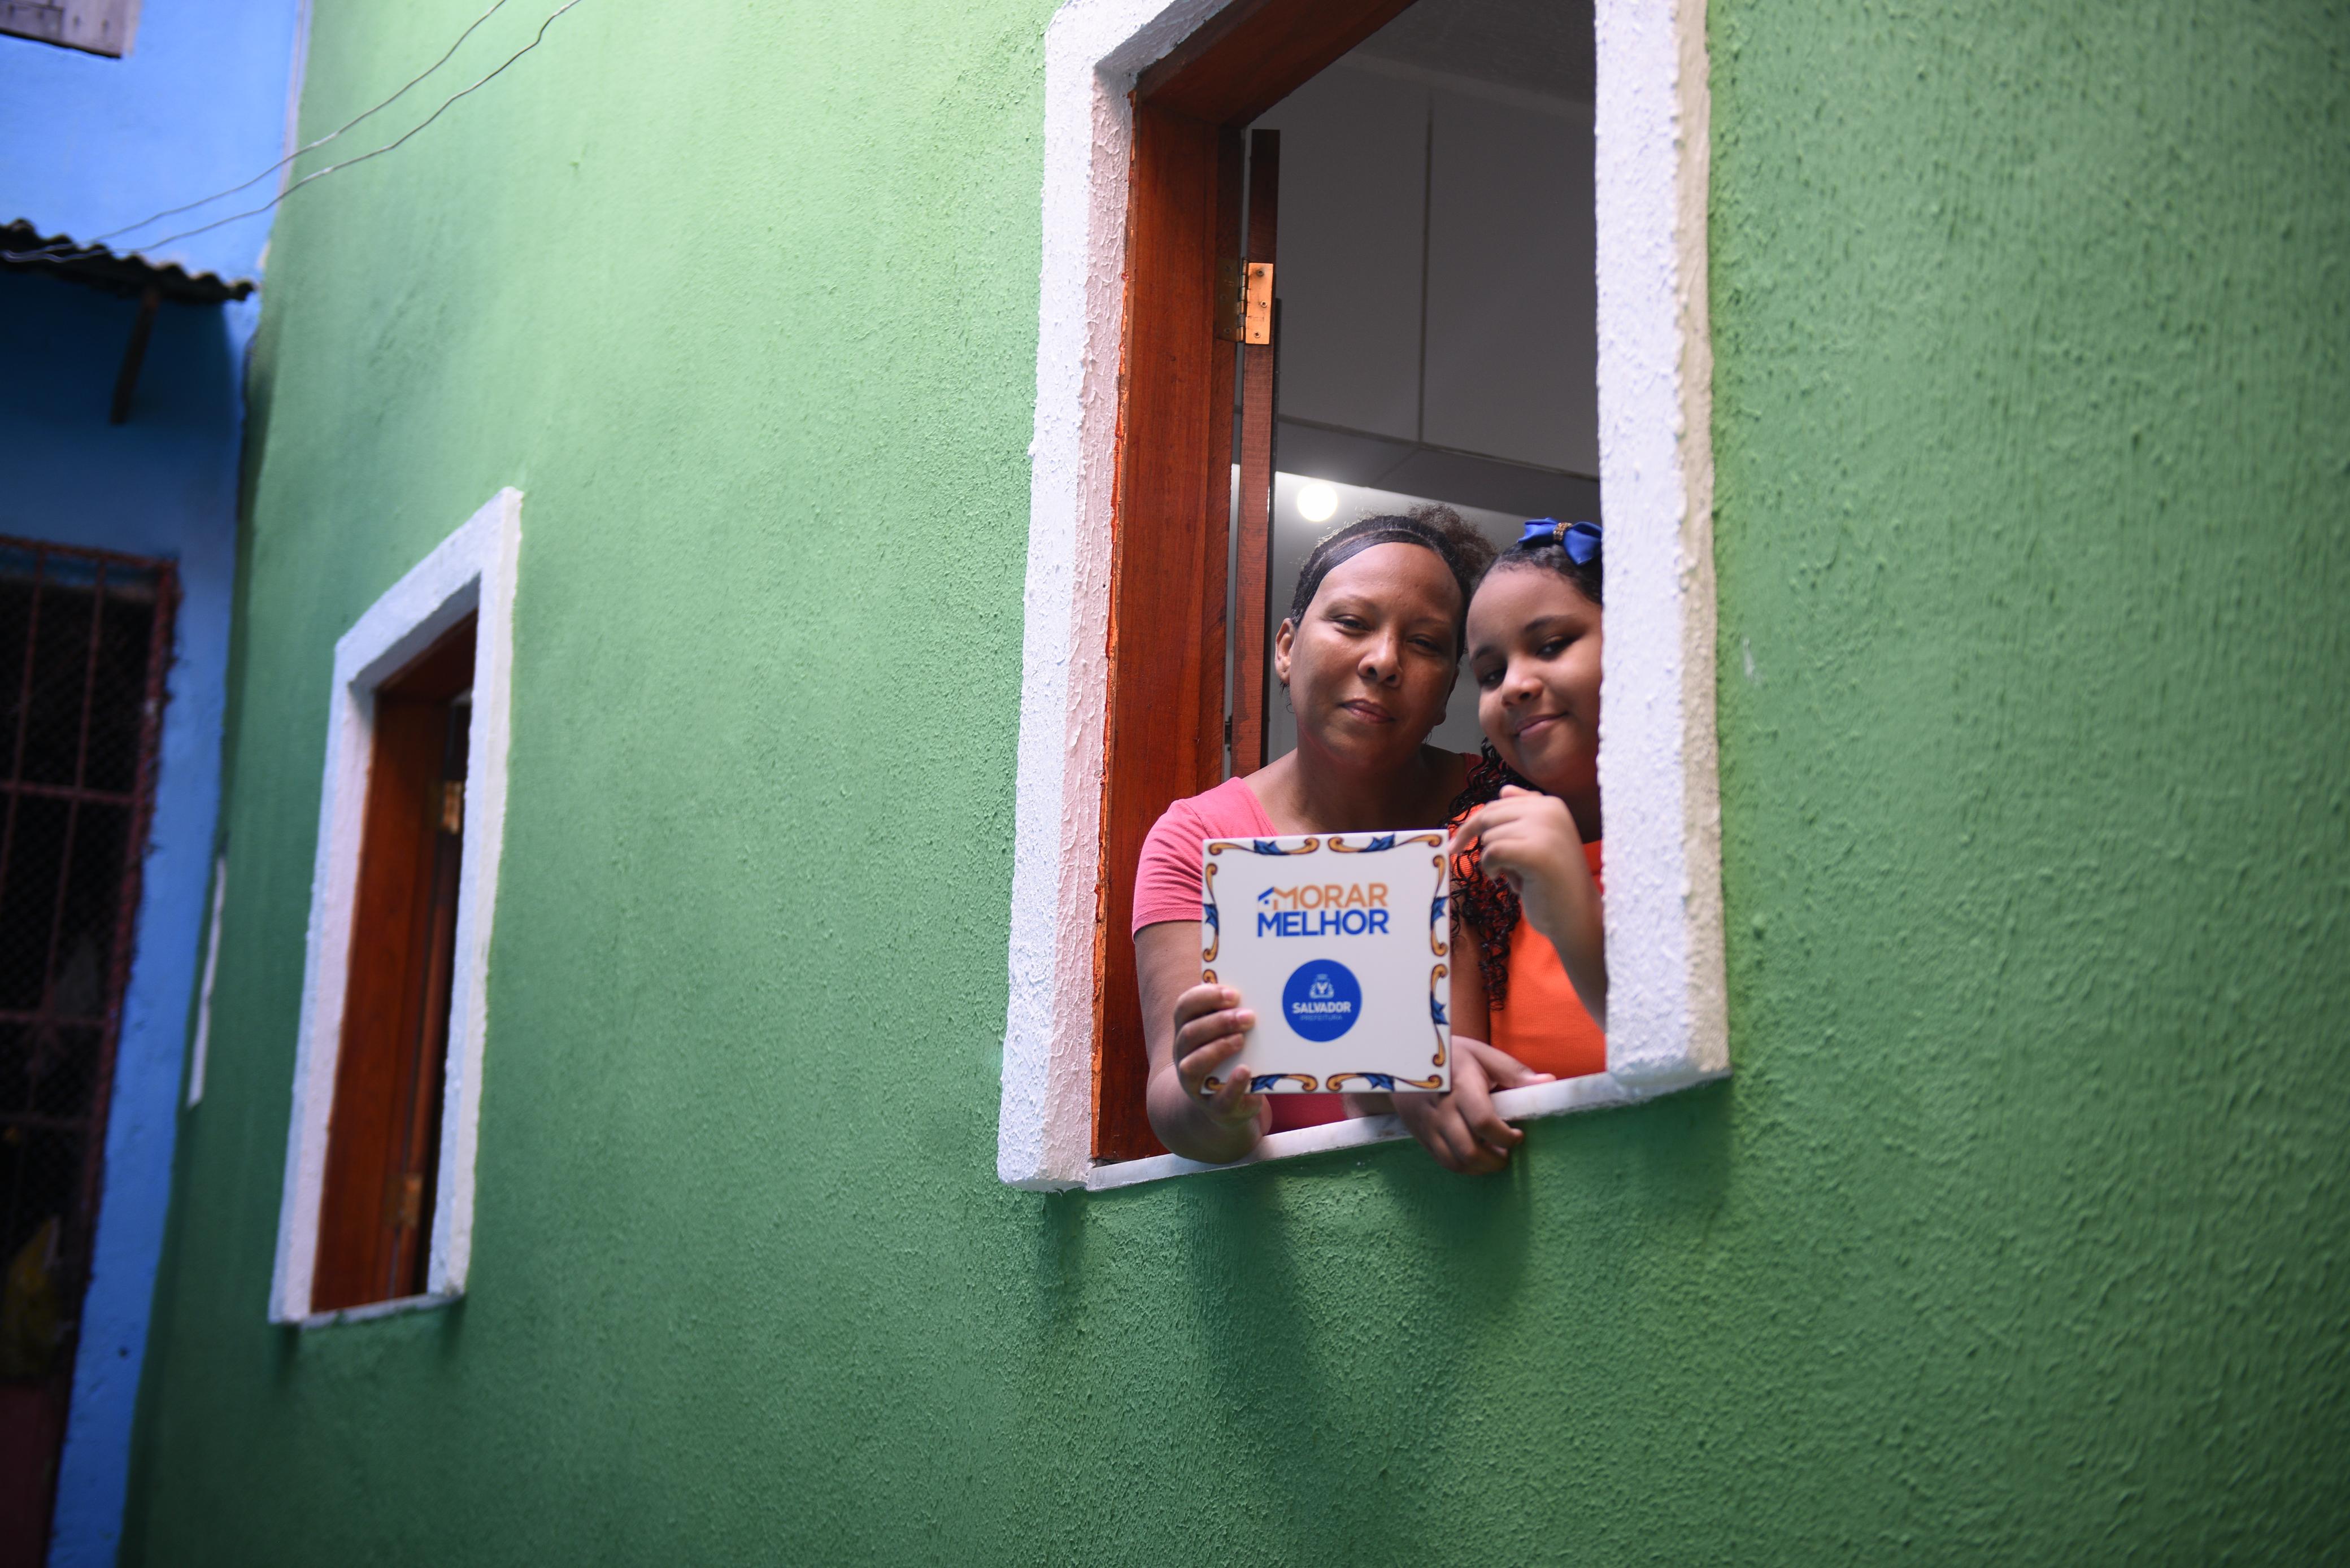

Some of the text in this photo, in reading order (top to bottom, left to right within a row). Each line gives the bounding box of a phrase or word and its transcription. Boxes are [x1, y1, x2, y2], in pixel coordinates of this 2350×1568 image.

[1272, 883, 1389, 910] MORAR
[1257, 909, 1389, 937] MELHOR
[1292, 1001, 1351, 1014] SALVADOR
